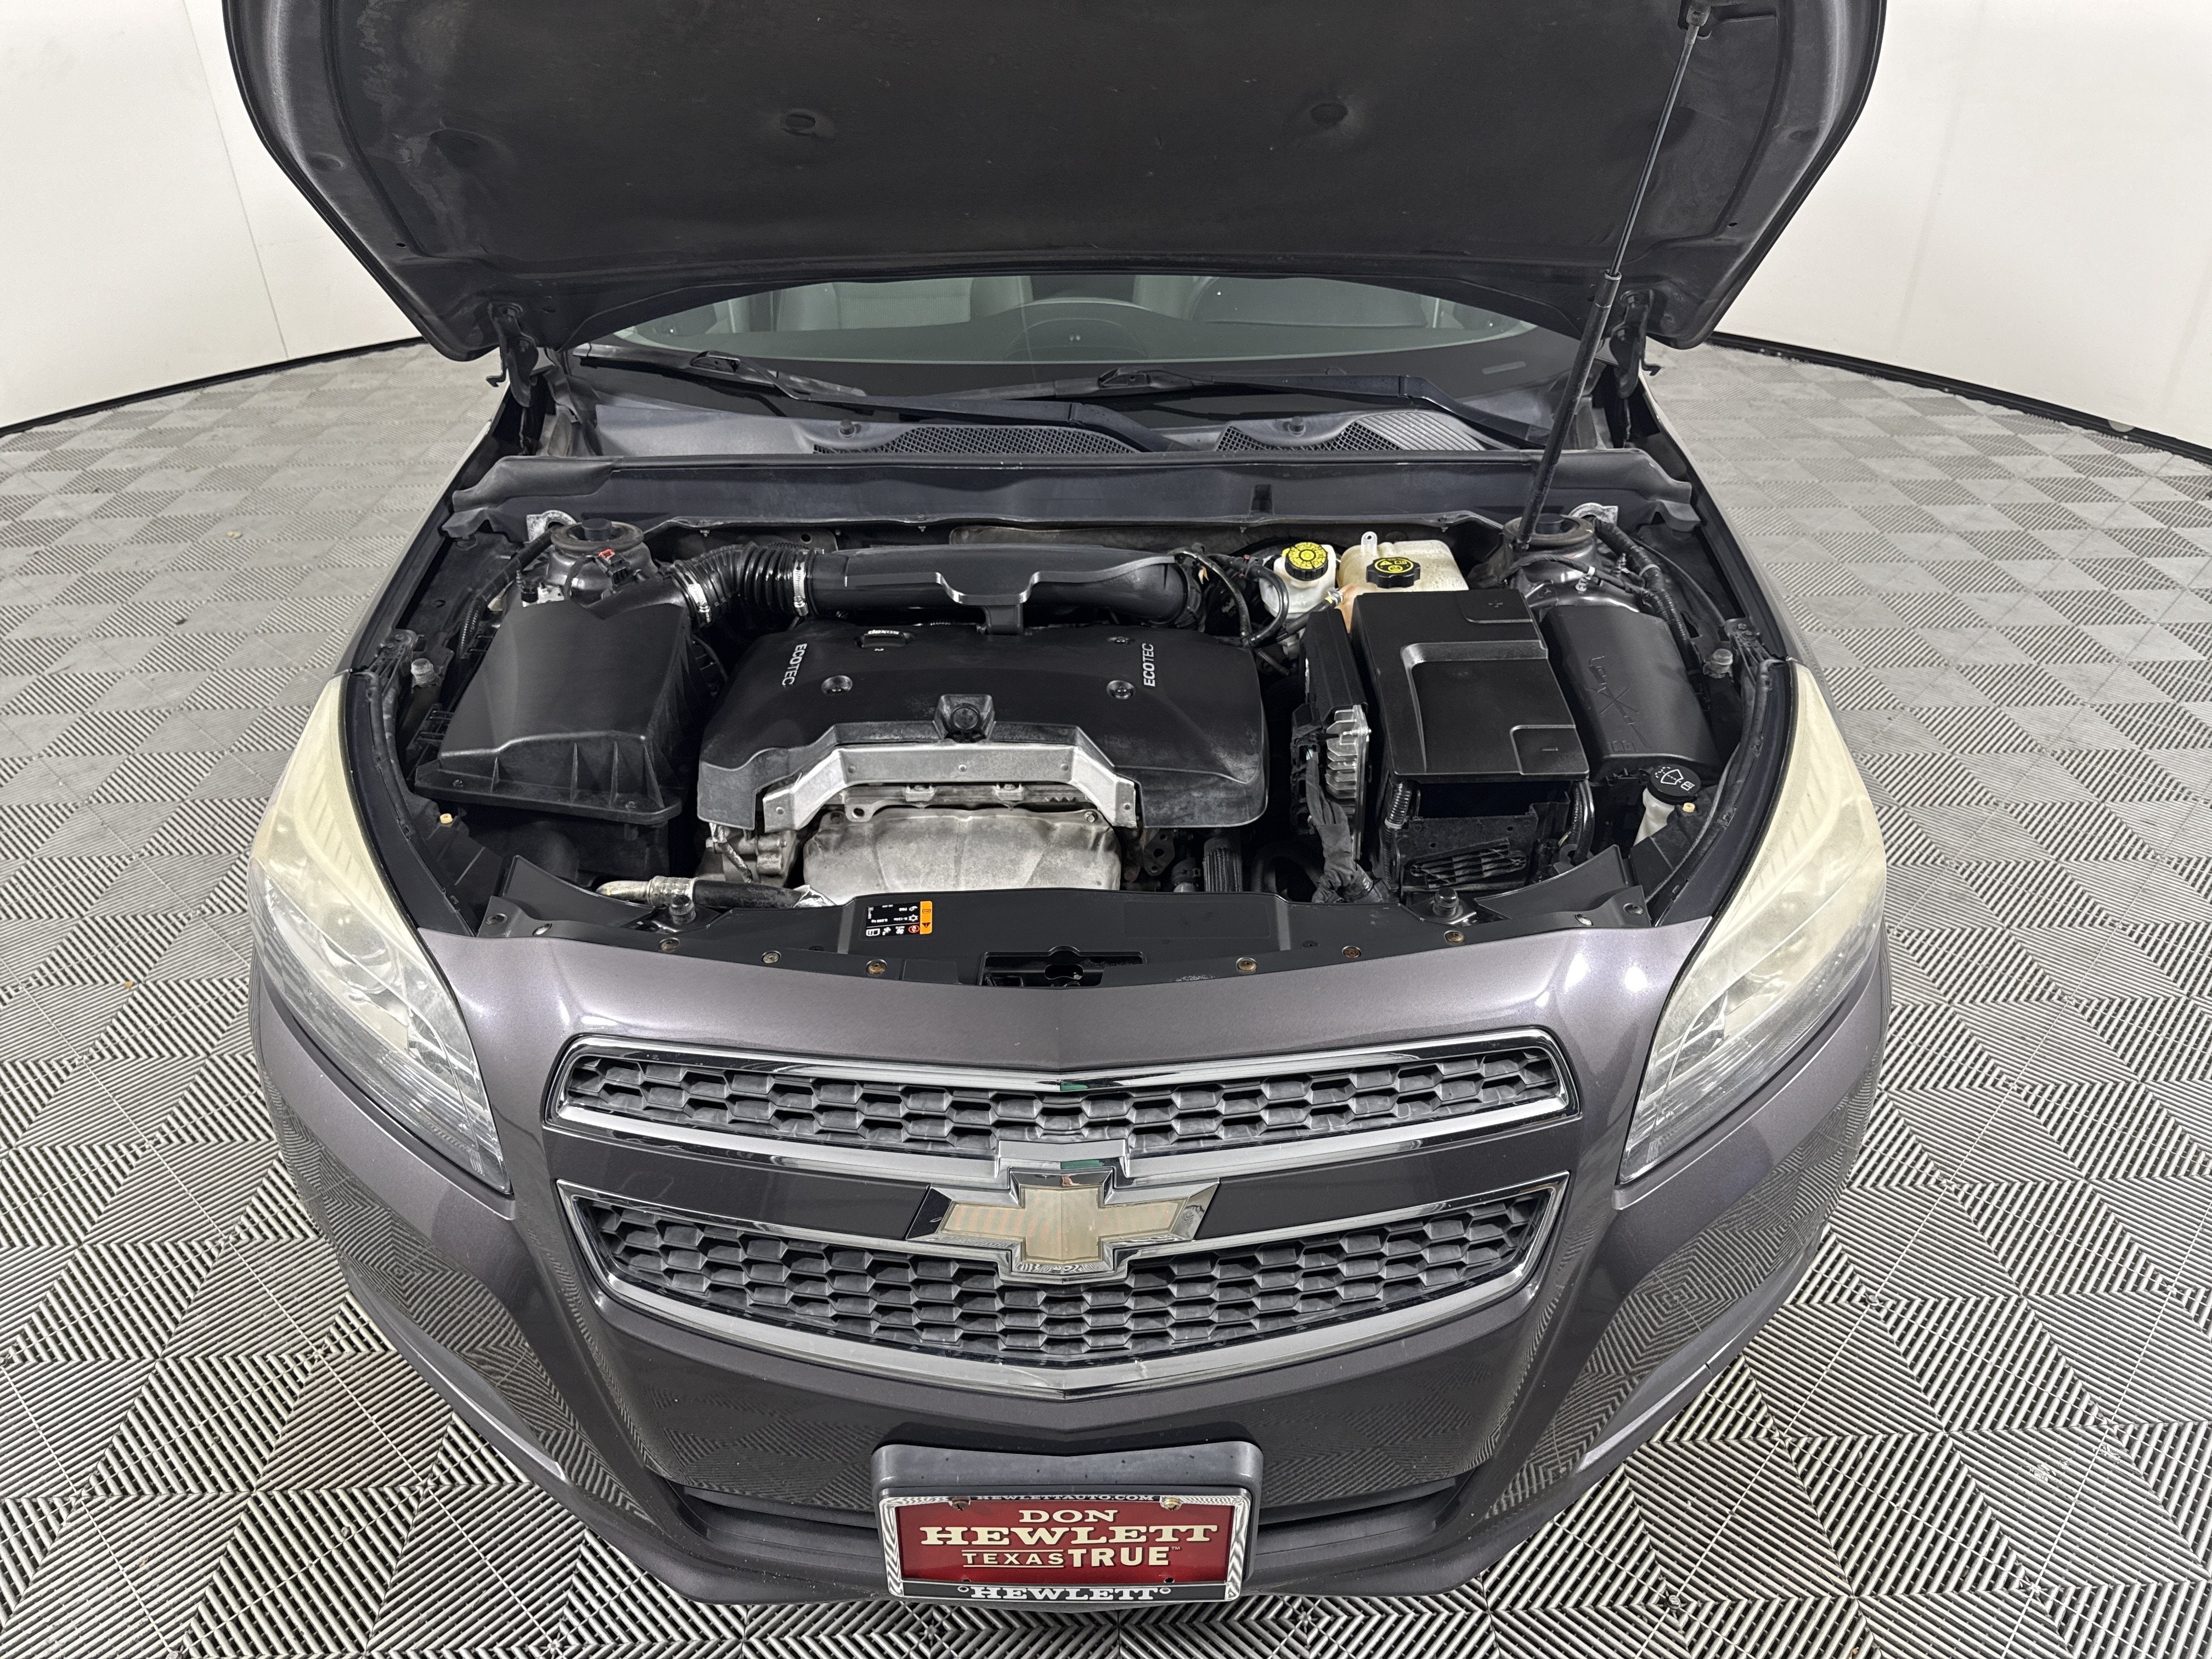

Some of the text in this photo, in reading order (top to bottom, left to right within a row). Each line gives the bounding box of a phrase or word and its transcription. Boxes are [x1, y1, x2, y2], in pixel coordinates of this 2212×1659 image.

[782, 643, 808, 686] ECOTEC
[1142, 643, 1155, 687] ECOTEC
[1018, 1509, 1118, 1523] DON
[919, 1525, 1217, 1545] HEWLETT
[970, 1587, 1159, 1600] HEWLETT
